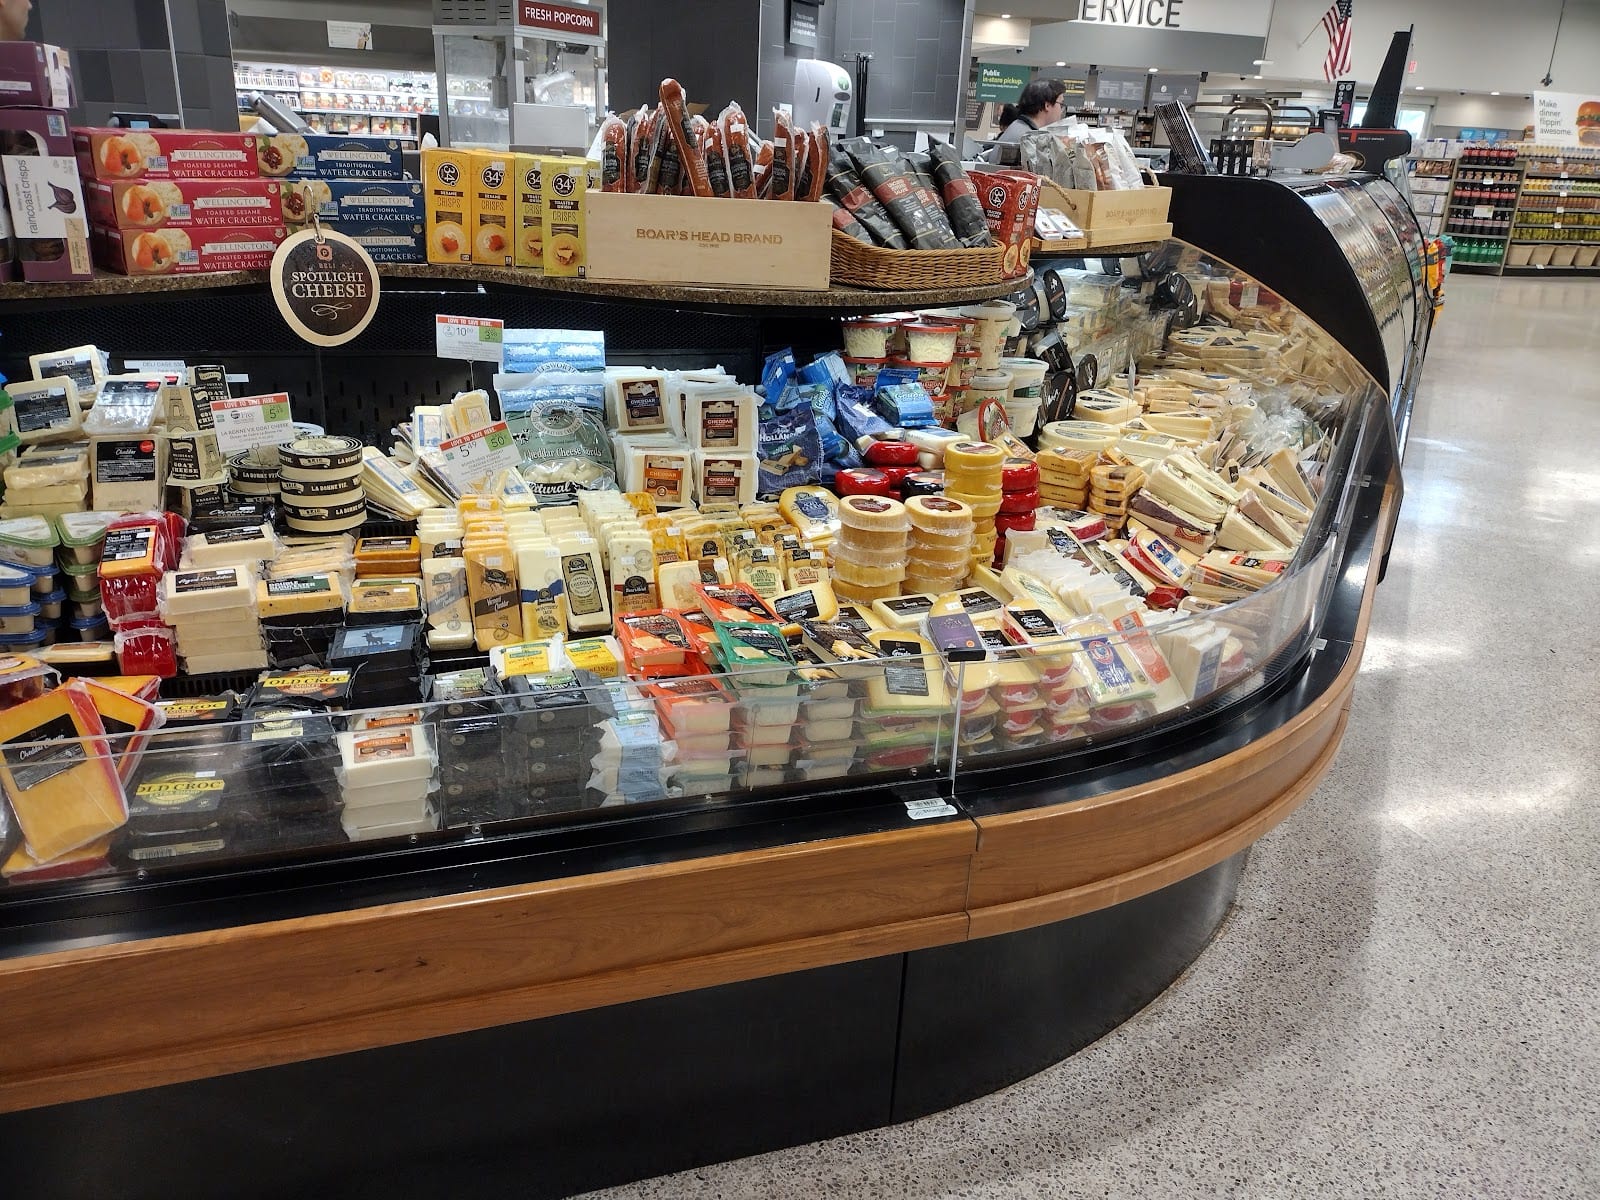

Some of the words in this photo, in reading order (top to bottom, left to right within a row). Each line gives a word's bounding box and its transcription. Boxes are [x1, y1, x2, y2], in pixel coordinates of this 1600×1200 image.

[525, 7, 552, 21] FRESH
[554, 11, 593, 27] POPCORN
[1081, 0, 1183, 27] ERVICE
[983, 68, 1000, 76] Publix
[1539, 99, 1558, 108] Make
[1539, 109, 1561, 117] dinner
[179, 151, 240, 159] WELLINGTON
[325, 150, 383, 160] WELLINGTON
[18, 159, 30, 189] crisps
[172, 169, 204, 177] WATER
[204, 169, 249, 177] CRACKERS
[319, 168, 348, 177] WATER
[349, 169, 393, 177] CRACKERS
[202, 198, 263, 207] WELLINGTON
[349, 196, 406, 204] WELLINGTON
[437, 196, 461, 208] CRISPS
[481, 200, 505, 211] CRISPS
[22, 190, 39, 234] raincoast
[553, 211, 577, 222] CRISPS
[195, 217, 226, 225] WATER
[227, 216, 273, 224] CRACKERS
[342, 213, 371, 221] WATER
[371, 213, 415, 221] CRACKERS
[636, 228, 689, 241] BOAR'S
[691, 231, 731, 242] HEAD
[733, 233, 783, 245] BRAND
[210, 242, 269, 251] WELLINGTON
[374, 252, 417, 261] CRACKERS
[203, 262, 233, 270] WATER
[291, 271, 364, 282] SPOTLIGHT
[291, 283, 367, 298] CHEESE
[450, 439, 462, 447] LOVE
[115, 448, 136, 456] Cheddar
[556, 446, 582, 457] Cheese
[529, 481, 571, 495] atural
[178, 576, 200, 585] Aged
[200, 574, 233, 582] Cheddar
[486, 595, 502, 606] Vermont
[304, 676, 347, 684] CROC
[138, 784, 172, 793] OLD
[173, 781, 223, 791] CROC
